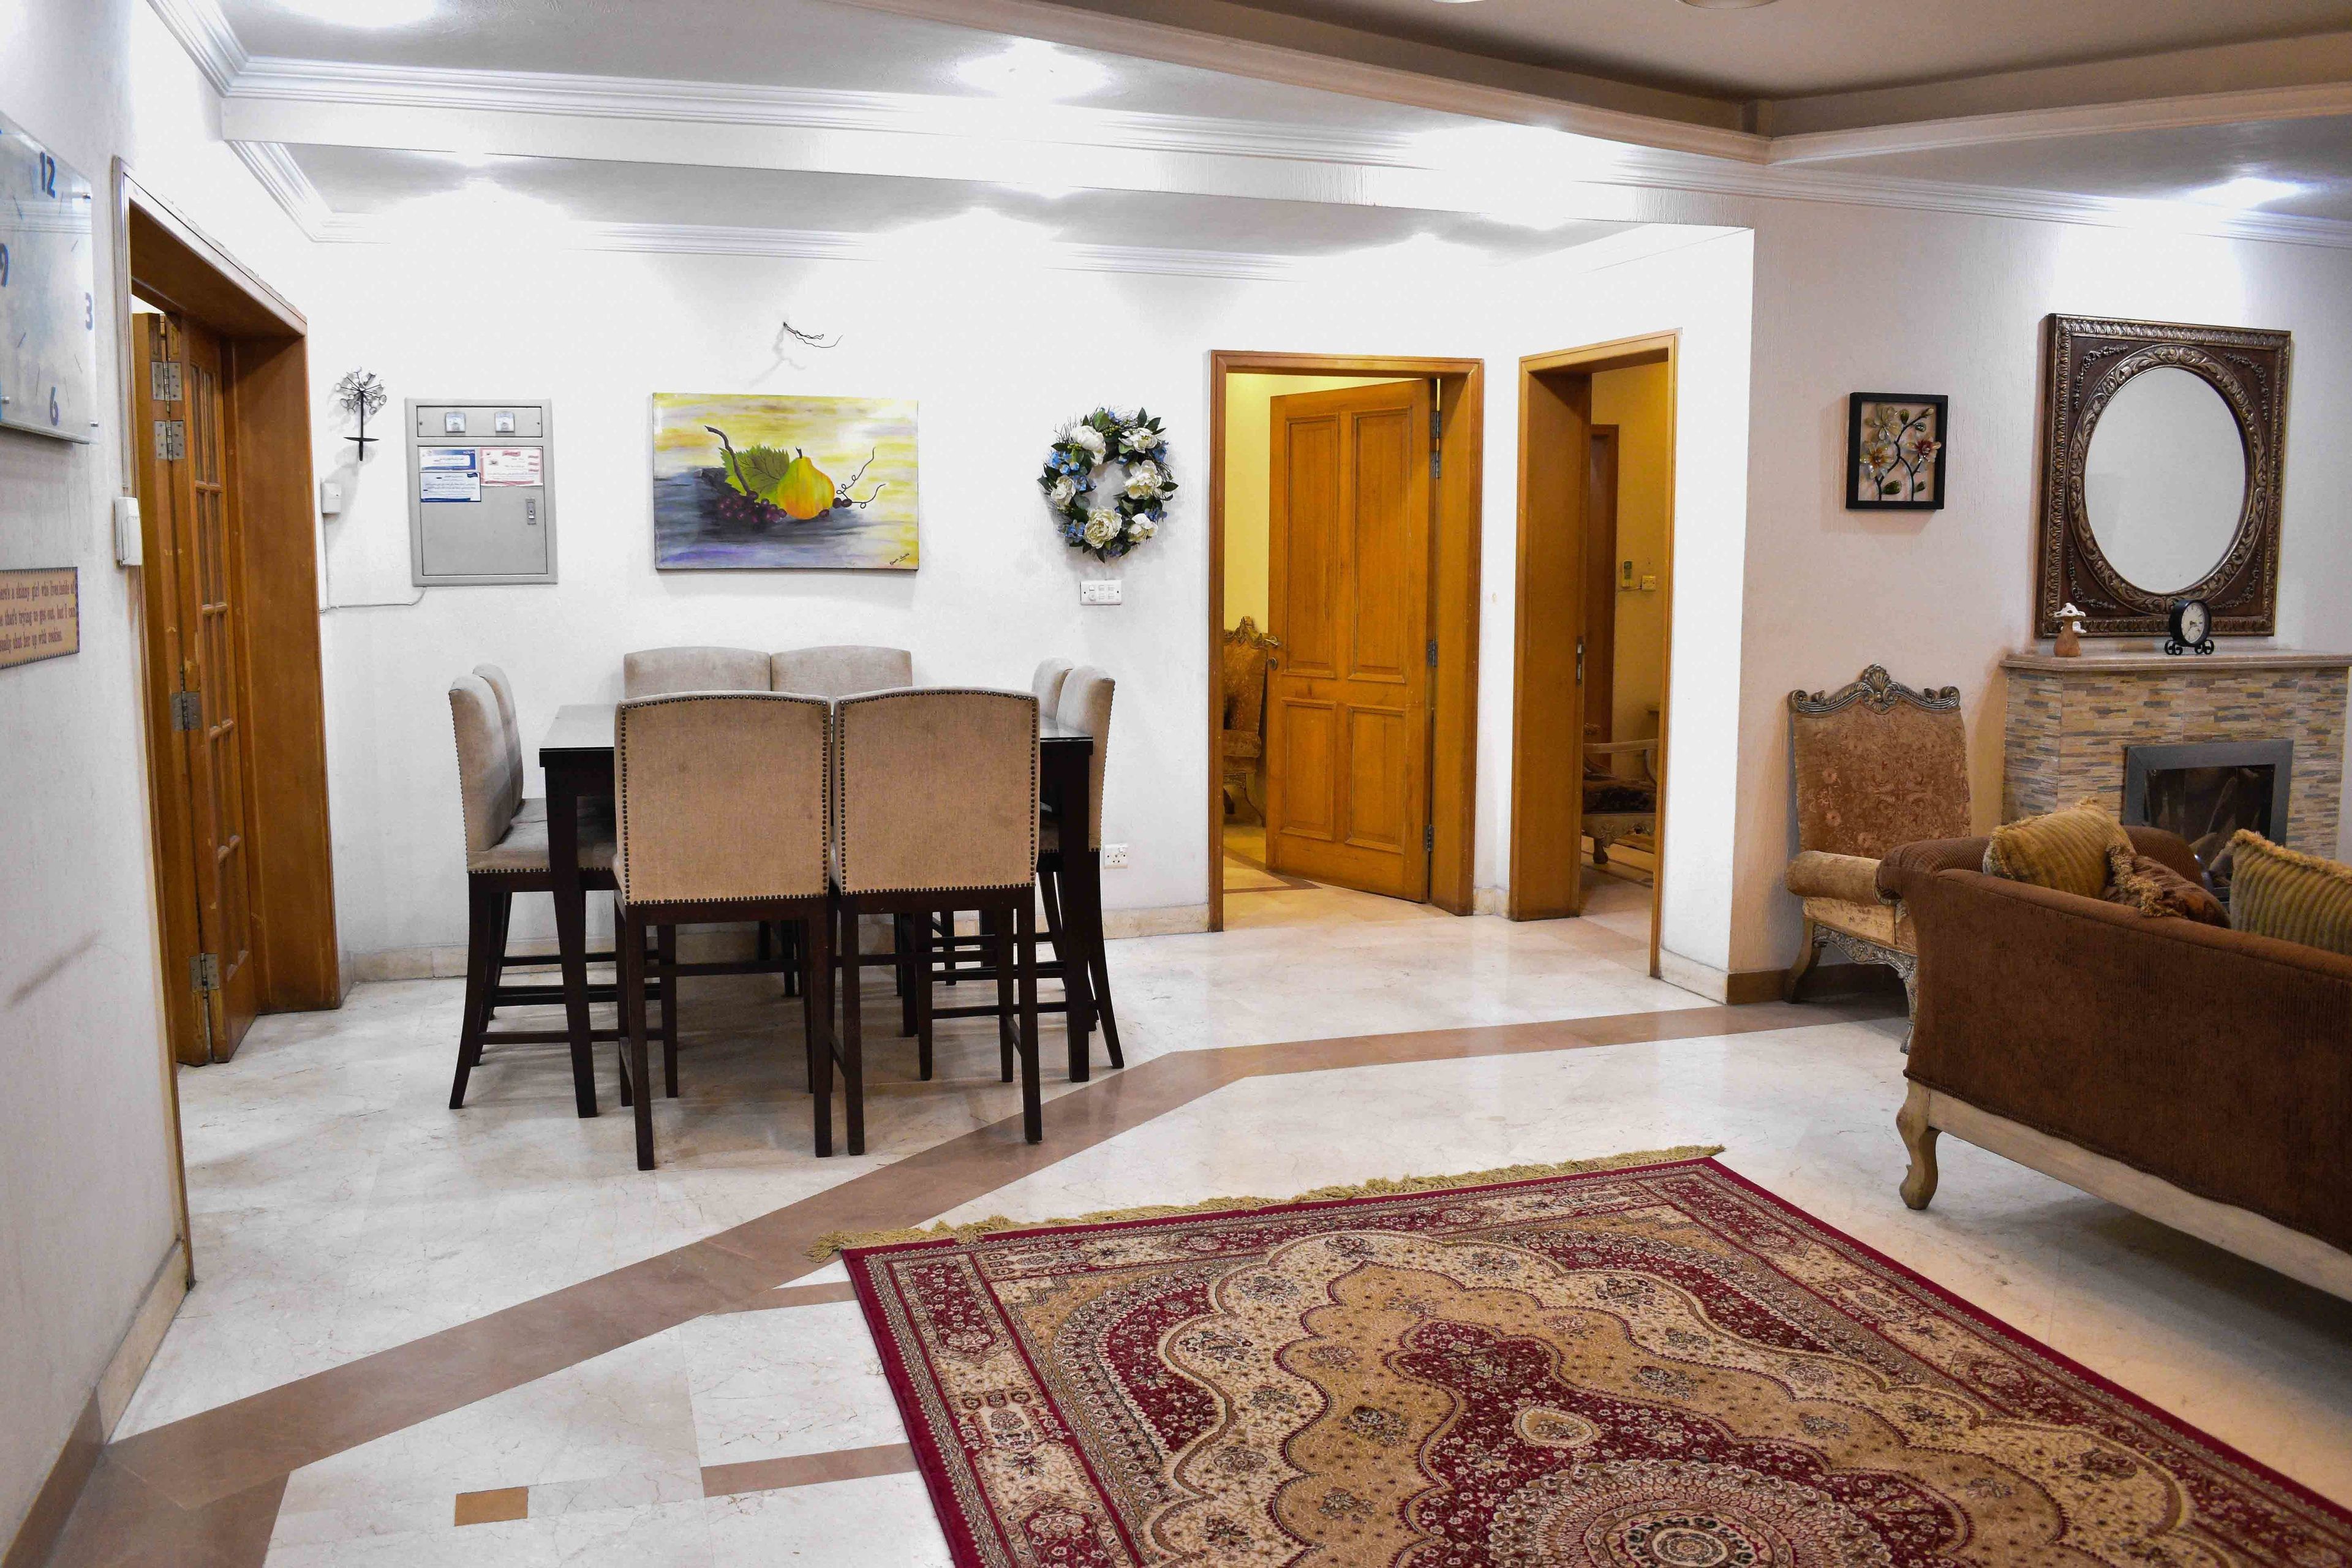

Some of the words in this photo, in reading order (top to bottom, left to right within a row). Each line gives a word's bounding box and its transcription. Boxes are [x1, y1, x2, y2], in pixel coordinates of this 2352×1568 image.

[39, 151, 56, 198] 12
[0, 243, 9, 287] 9
[85, 292, 93, 331] 3
[50, 386, 59, 426] 6
